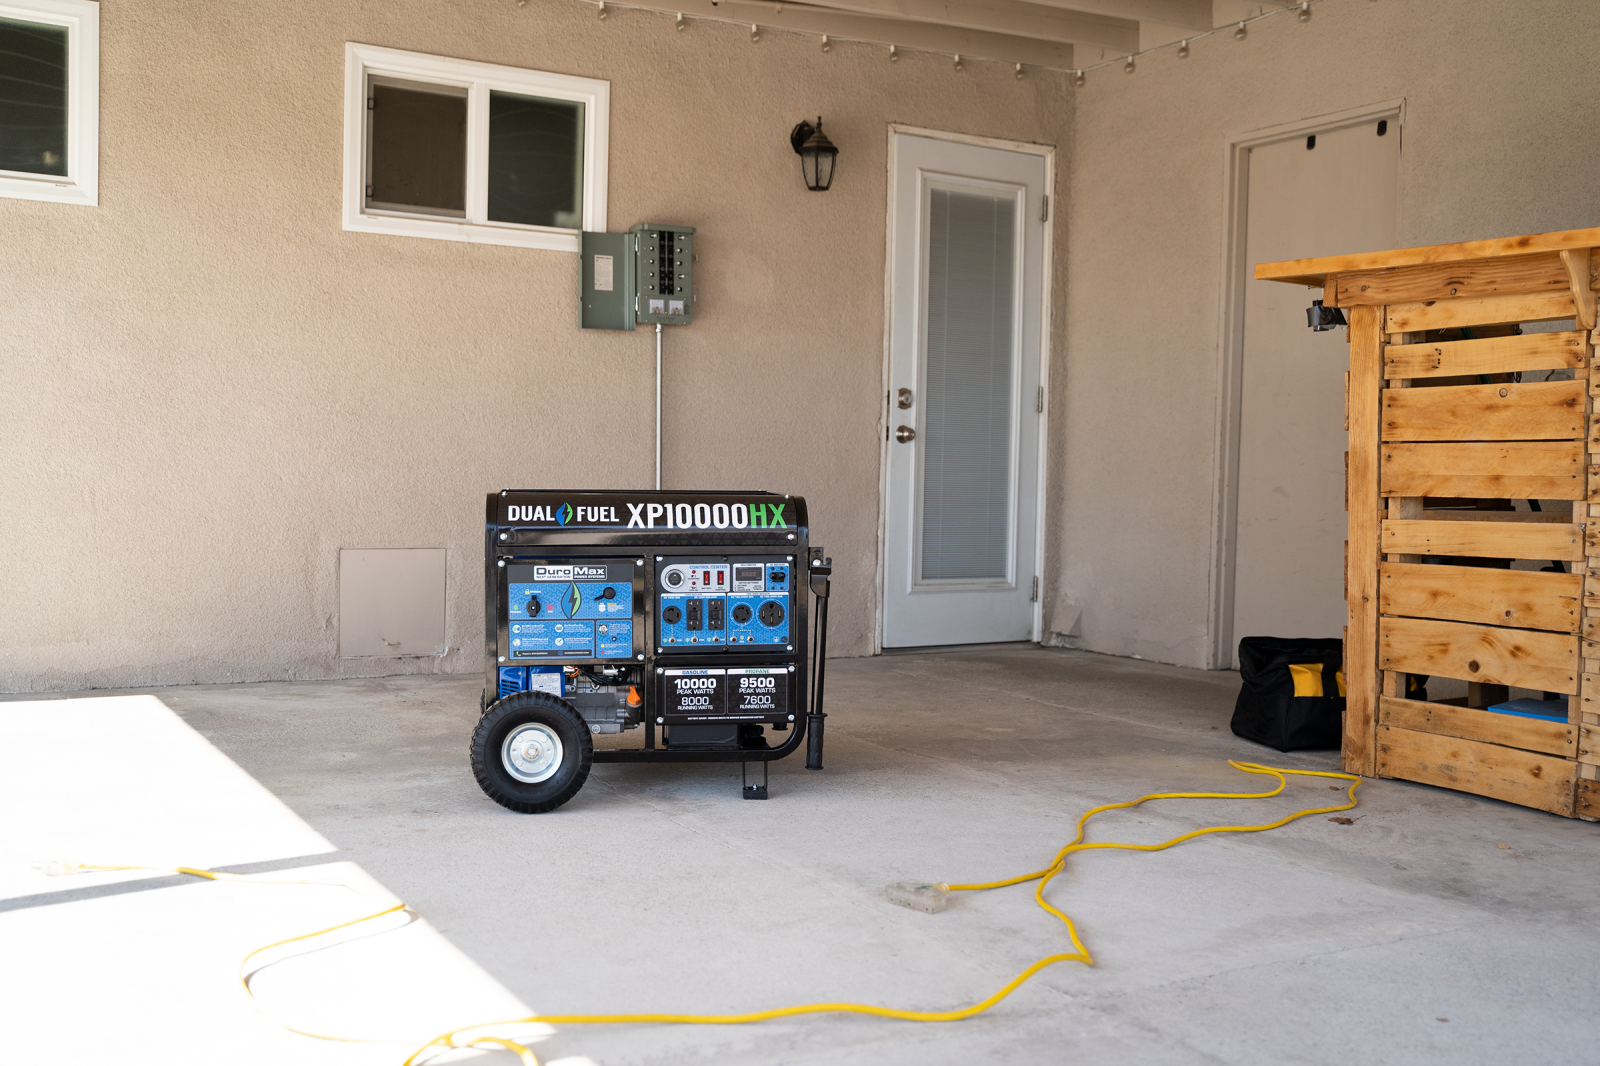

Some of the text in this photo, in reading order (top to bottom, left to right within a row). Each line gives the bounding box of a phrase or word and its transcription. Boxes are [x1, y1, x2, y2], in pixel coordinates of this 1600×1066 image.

[507, 505, 620, 523] DUAL FUEL
[626, 503, 788, 529] XP10000HX
[674, 678, 717, 689] 10000
[740, 677, 775, 688] 9500
[681, 696, 709, 706] 8000
[744, 696, 771, 704] 7600
